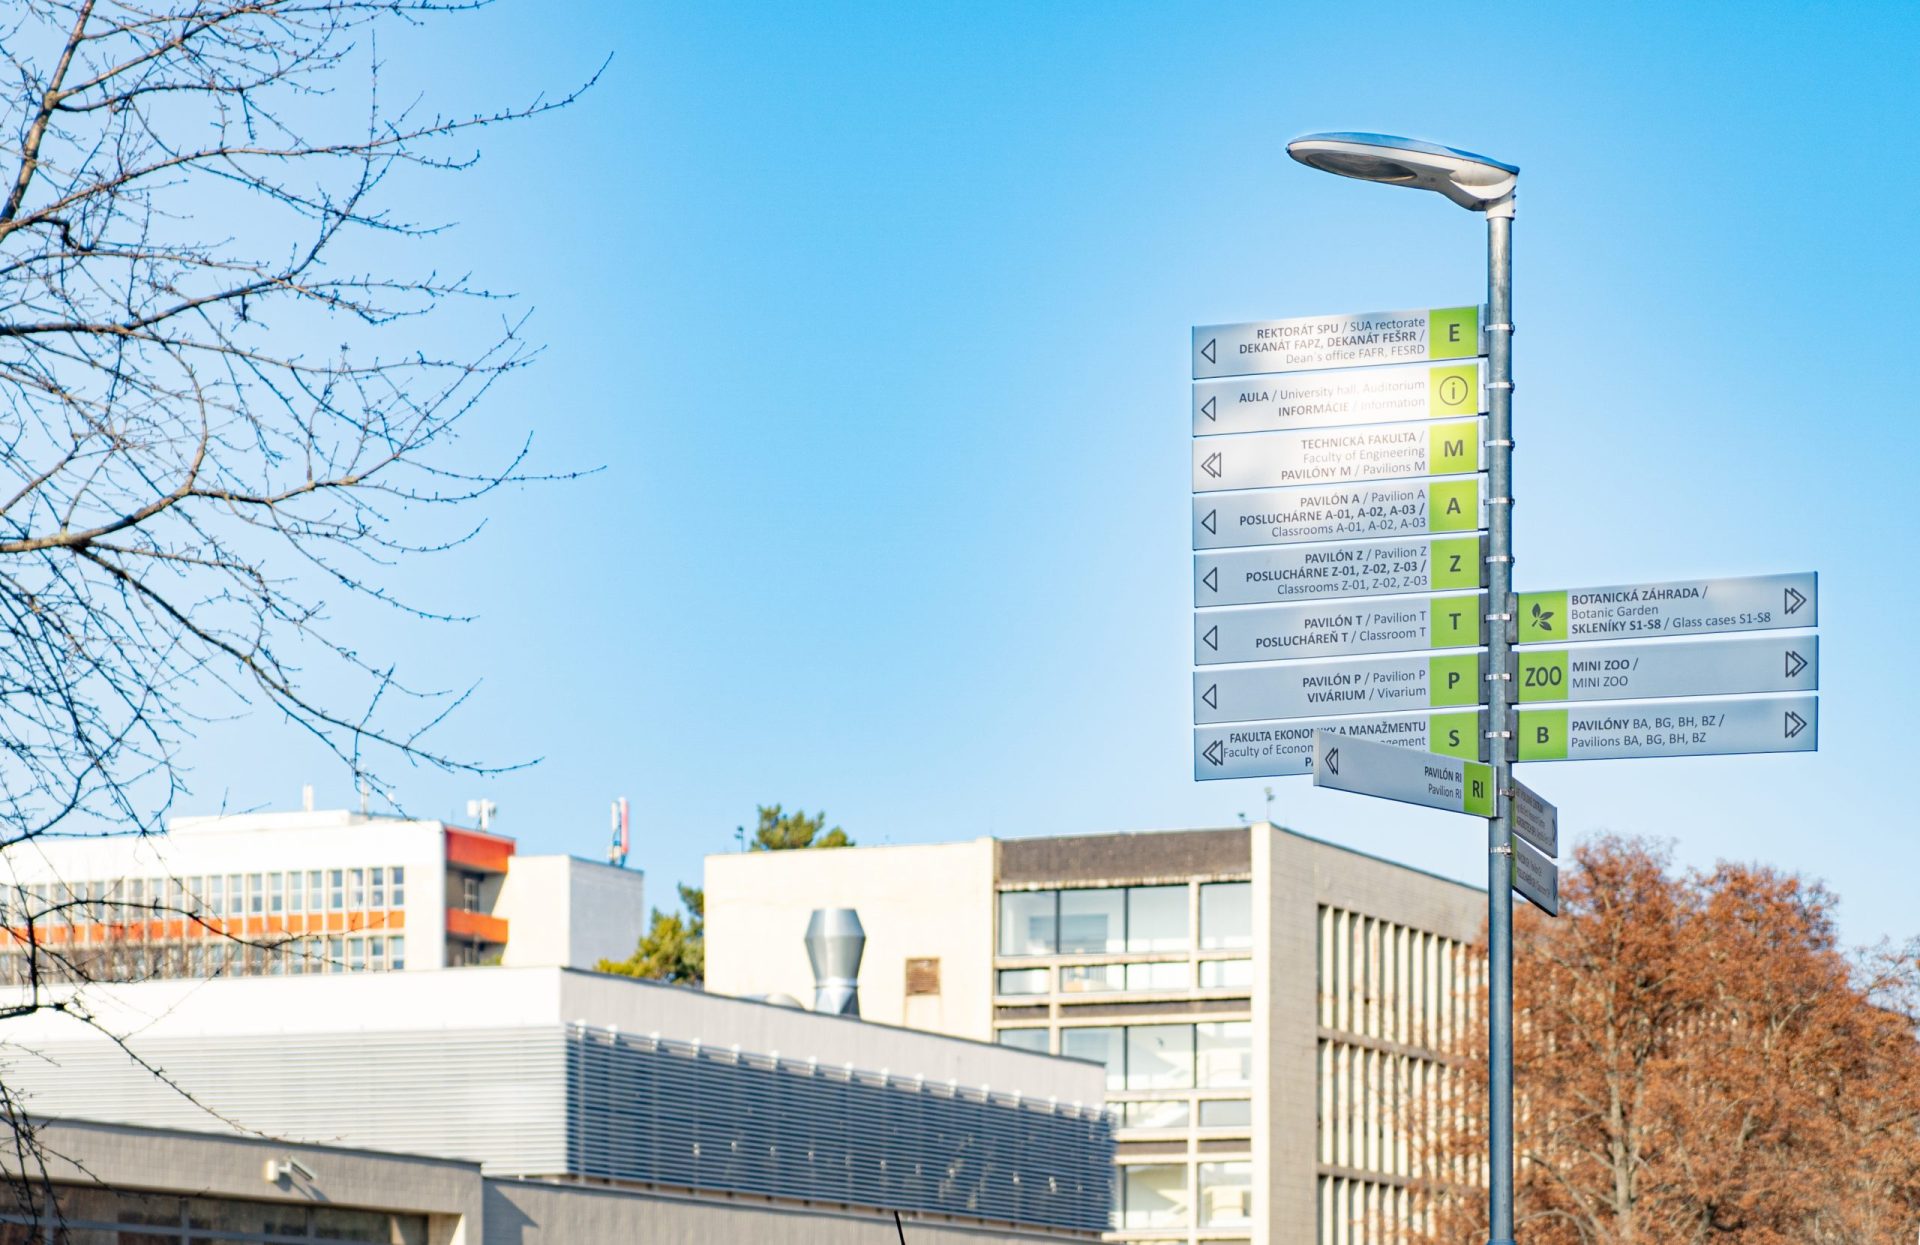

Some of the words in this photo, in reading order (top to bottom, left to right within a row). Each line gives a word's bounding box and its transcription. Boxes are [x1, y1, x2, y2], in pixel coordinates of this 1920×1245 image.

[1257, 322, 1314, 339] REKTORÁT
[1318, 322, 1338, 335] SPU
[1351, 320, 1372, 332] SUA
[1376, 318, 1425, 330] rectorate
[1449, 324, 1460, 342] E
[1239, 337, 1290, 354] DEKANÁT
[1328, 331, 1379, 347] DEKANÁT
[1383, 328, 1416, 343] FEŠRR
[1326, 348, 1355, 361] office
[1391, 343, 1424, 357] FESRD
[1239, 390, 1268, 403] AULA
[1301, 434, 1364, 450] TECHNICKÁ
[1368, 431, 1416, 445] FAKULTA
[1444, 440, 1463, 458] M
[1304, 450, 1341, 464] Faculty
[1346, 450, 1355, 461] of
[1360, 445, 1424, 461] Engineering
[1281, 464, 1335, 480] PAVILÓNY
[1340, 465, 1350, 476] M
[1364, 461, 1411, 475] Pavilions
[1415, 460, 1425, 471] M
[1300, 491, 1349, 507] PAVILÓN
[1352, 492, 1360, 504] A
[1372, 489, 1413, 502] Pavilion
[1417, 488, 1424, 499] A
[1446, 498, 1460, 515] A
[1240, 508, 1322, 526] POSLUCHÁRNE
[1325, 507, 1354, 520] A-01,
[1358, 505, 1387, 518] A-02,
[1390, 503, 1415, 516] A-03
[1272, 522, 1333, 537] Classrooms
[1336, 520, 1365, 533] A-01,
[1369, 518, 1397, 531] A-02,
[1401, 517, 1425, 529] A-03
[1305, 547, 1353, 563] PAVILÓN
[1357, 549, 1363, 560] Z
[1375, 546, 1416, 559] Pavilion
[1420, 545, 1426, 556] Z
[1246, 565, 1328, 582] POSLUCHÁRNE
[1332, 564, 1360, 577] Z-01,
[1363, 562, 1390, 575] Z-02,
[1393, 560, 1417, 573] Z-03
[1450, 555, 1461, 572] Z
[1277, 580, 1339, 595] Classrooms
[1342, 578, 1369, 591] Z-01,
[1373, 576, 1400, 589] Z-02,
[1403, 575, 1427, 587] Z-03
[1572, 588, 1638, 605] BOTANICKÁ
[1642, 587, 1699, 601] ZÁHRADA
[1305, 613, 1352, 629] PAVILÓN
[1356, 614, 1363, 625] T
[1374, 611, 1416, 624] Pavilion
[1419, 610, 1426, 621] T
[1571, 607, 1613, 620] Botanic
[1617, 604, 1658, 617] Garden
[1449, 613, 1461, 630] T
[1572, 619, 1626, 634] SKLENÍKY
[1629, 618, 1661, 631] S1-S8
[1673, 616, 1702, 628] Glass
[1705, 616, 1736, 627] cases
[1740, 612, 1770, 625] S1-S8
[1256, 630, 1338, 648] POSLUCHÁREŇ
[1341, 632, 1348, 643] T
[1360, 627, 1416, 642] Classroom
[1419, 626, 1426, 638] T
[1573, 660, 1601, 672] MINI
[1604, 658, 1629, 670] ZOO
[1303, 671, 1351, 687] PAVILÓN
[1355, 673, 1361, 684] P
[1373, 669, 1416, 683] Pavilion
[1419, 668, 1425, 679] P
[1448, 672, 1460, 689] P
[1525, 666, 1562, 687] ZOO
[1573, 677, 1600, 689] MINI
[1603, 676, 1628, 687] ZOO
[1307, 688, 1365, 703] VIVÁRIUM
[1377, 685, 1425, 699] Vivarium
[1230, 730, 1271, 743] FAKULTA
[1340, 725, 1347, 737] A
[1349, 720, 1425, 736] MANAŽMENTU
[1572, 716, 1629, 731] PAVILÓNY
[1633, 717, 1651, 730] BA,
[1655, 717, 1675, 729] BG,
[1679, 716, 1697, 728] BH,
[1702, 715, 1715, 726] BZ
[1449, 730, 1459, 747] S
[1537, 727, 1549, 744] B
[1572, 735, 1620, 748] Pavilions
[1624, 735, 1642, 747] BA,
[1646, 734, 1665, 746] BG,
[1669, 733, 1688, 745] BH,
[1693, 732, 1706, 743] BZ
[1223, 745, 1259, 758] Faculty
[1263, 744, 1273, 756] of
[1424, 766, 1453, 782] PAVILÓN
[1455, 771, 1462, 783] RI
[1428, 783, 1453, 798] Pavilion
[1455, 787, 1462, 799] RI
[1472, 780, 1483, 799] RI
